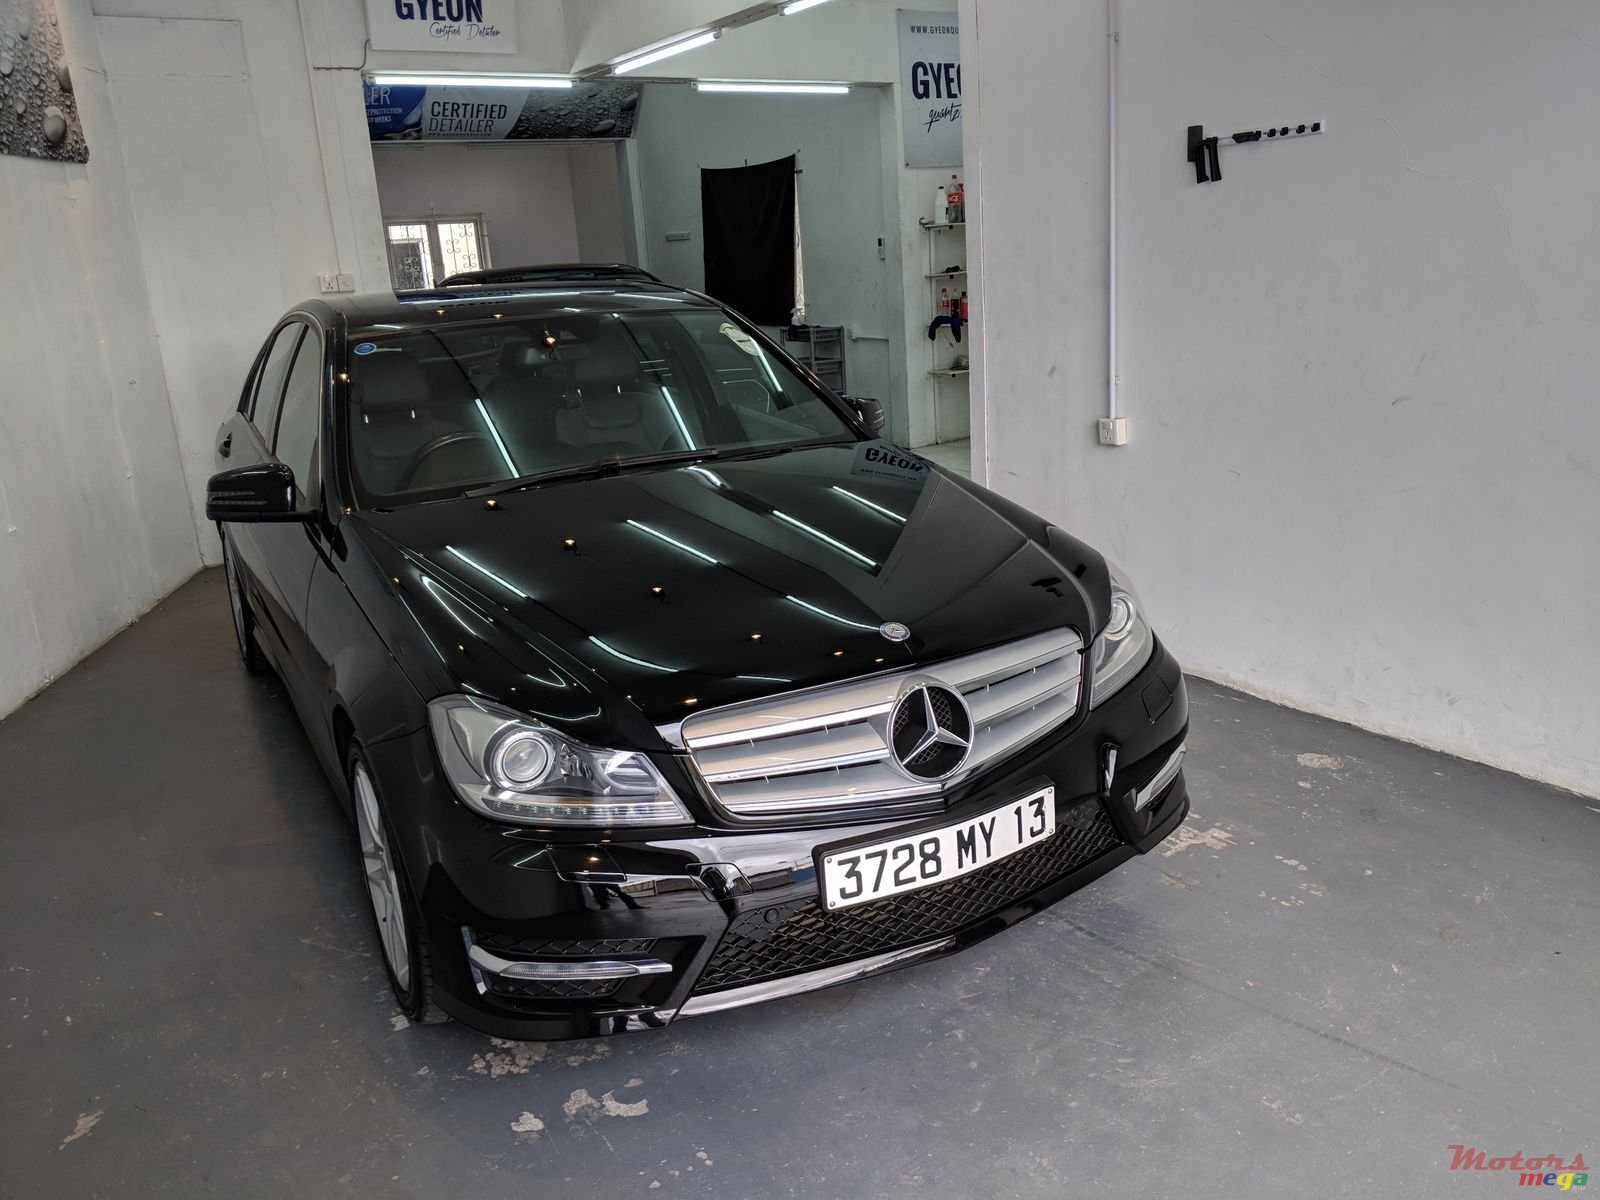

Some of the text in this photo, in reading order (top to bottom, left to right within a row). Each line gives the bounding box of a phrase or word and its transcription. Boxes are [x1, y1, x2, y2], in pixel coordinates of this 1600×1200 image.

[395, 0, 483, 23] GYEON
[429, 21, 461, 42] Certified
[431, 101, 508, 120] CERTIFIED
[429, 117, 495, 133] DETAILER
[837, 795, 1047, 900] 3728 MY 13
